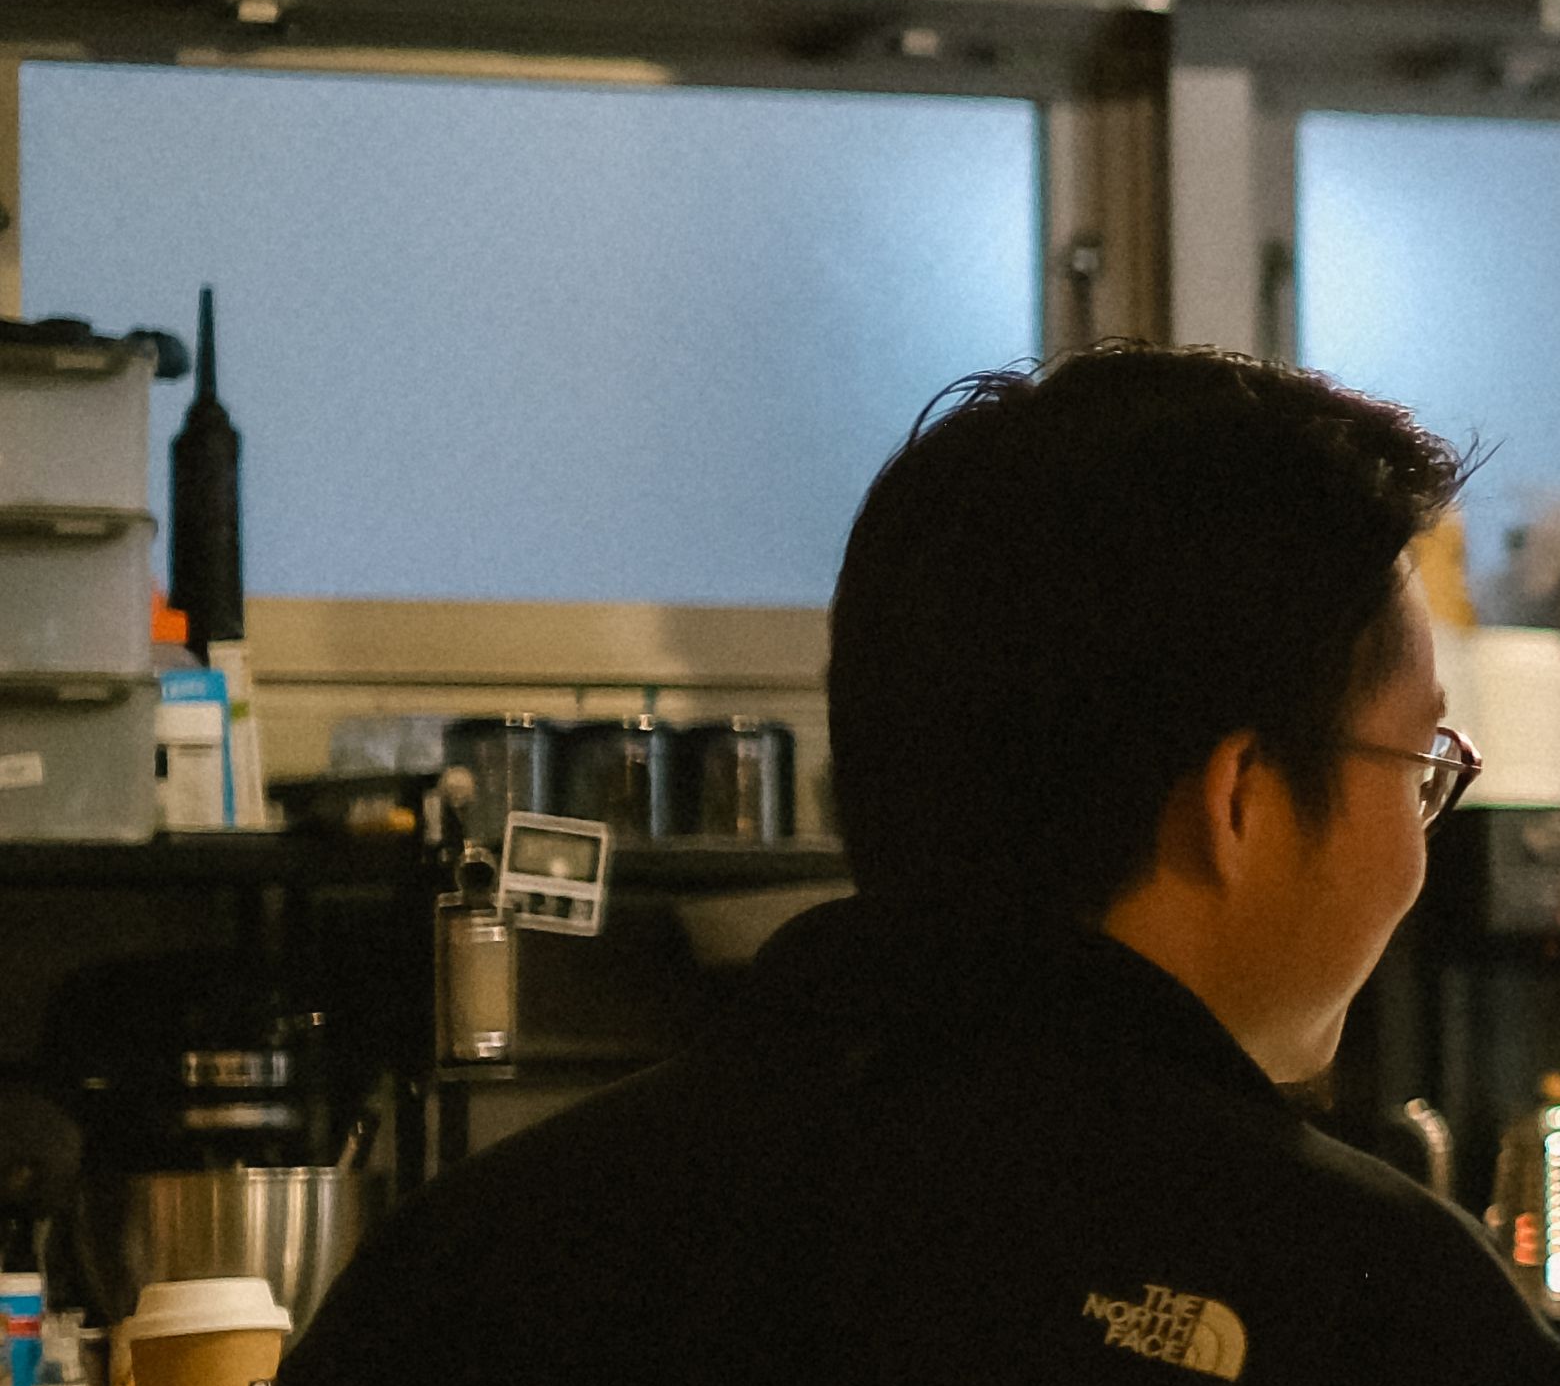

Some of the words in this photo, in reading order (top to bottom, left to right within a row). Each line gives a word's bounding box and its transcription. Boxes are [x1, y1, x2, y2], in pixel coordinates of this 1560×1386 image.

[1082, 1293, 1196, 1342] NORTH
[1143, 1284, 1204, 1319] THE
[1104, 1323, 1186, 1365] FACE
